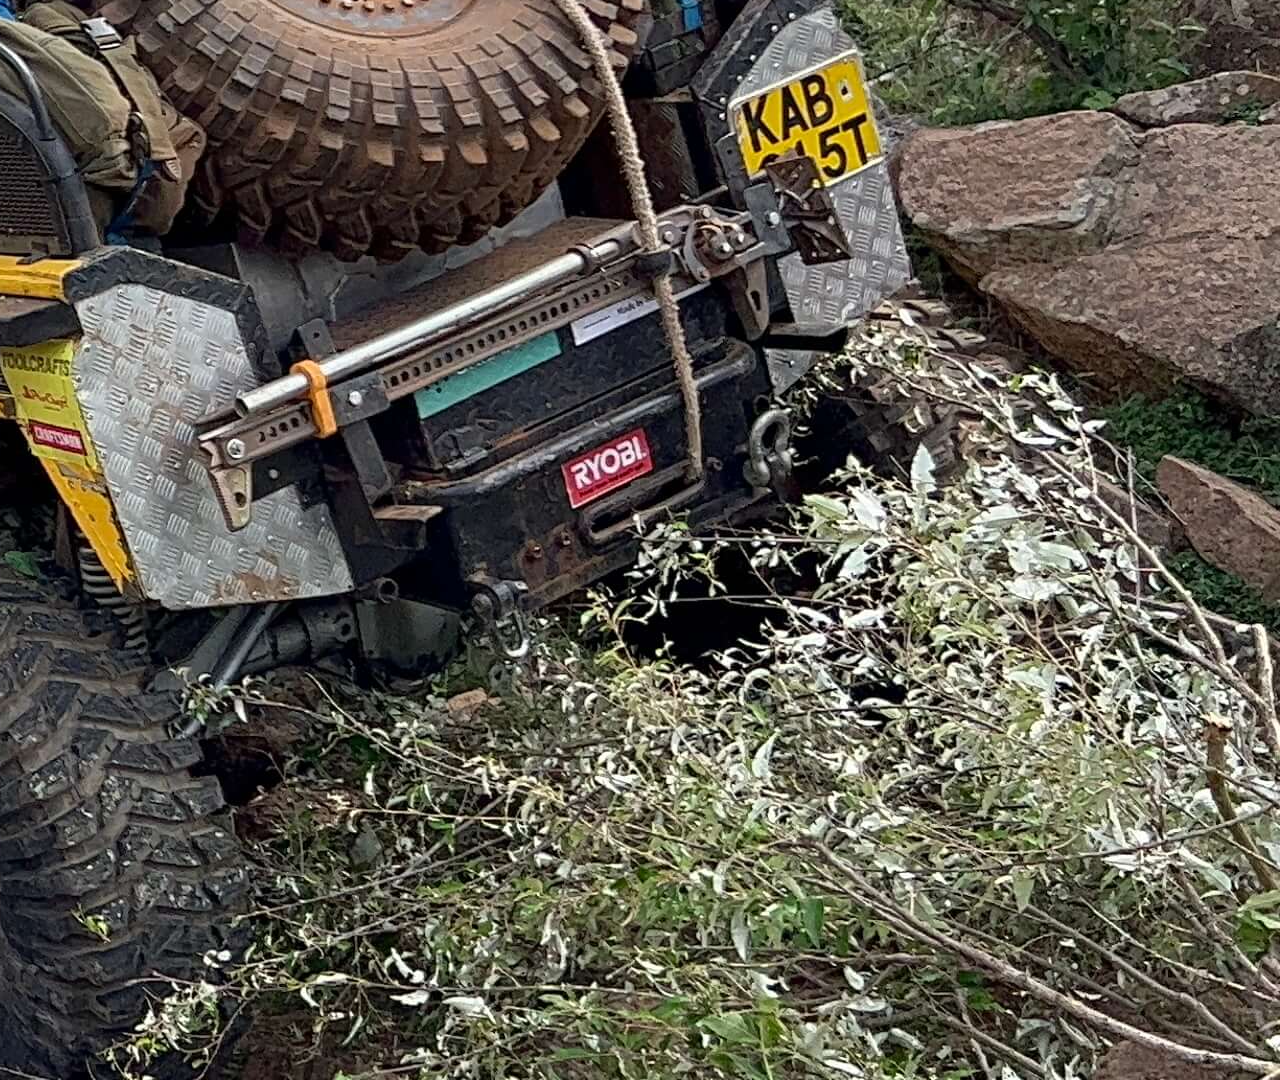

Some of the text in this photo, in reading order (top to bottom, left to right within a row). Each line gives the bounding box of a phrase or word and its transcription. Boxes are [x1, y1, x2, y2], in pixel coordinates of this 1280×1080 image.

[742, 74, 834, 153] KAB
[2, 351, 71, 376] TOOLCRAFTS
[570, 436, 646, 489] RYOBI
